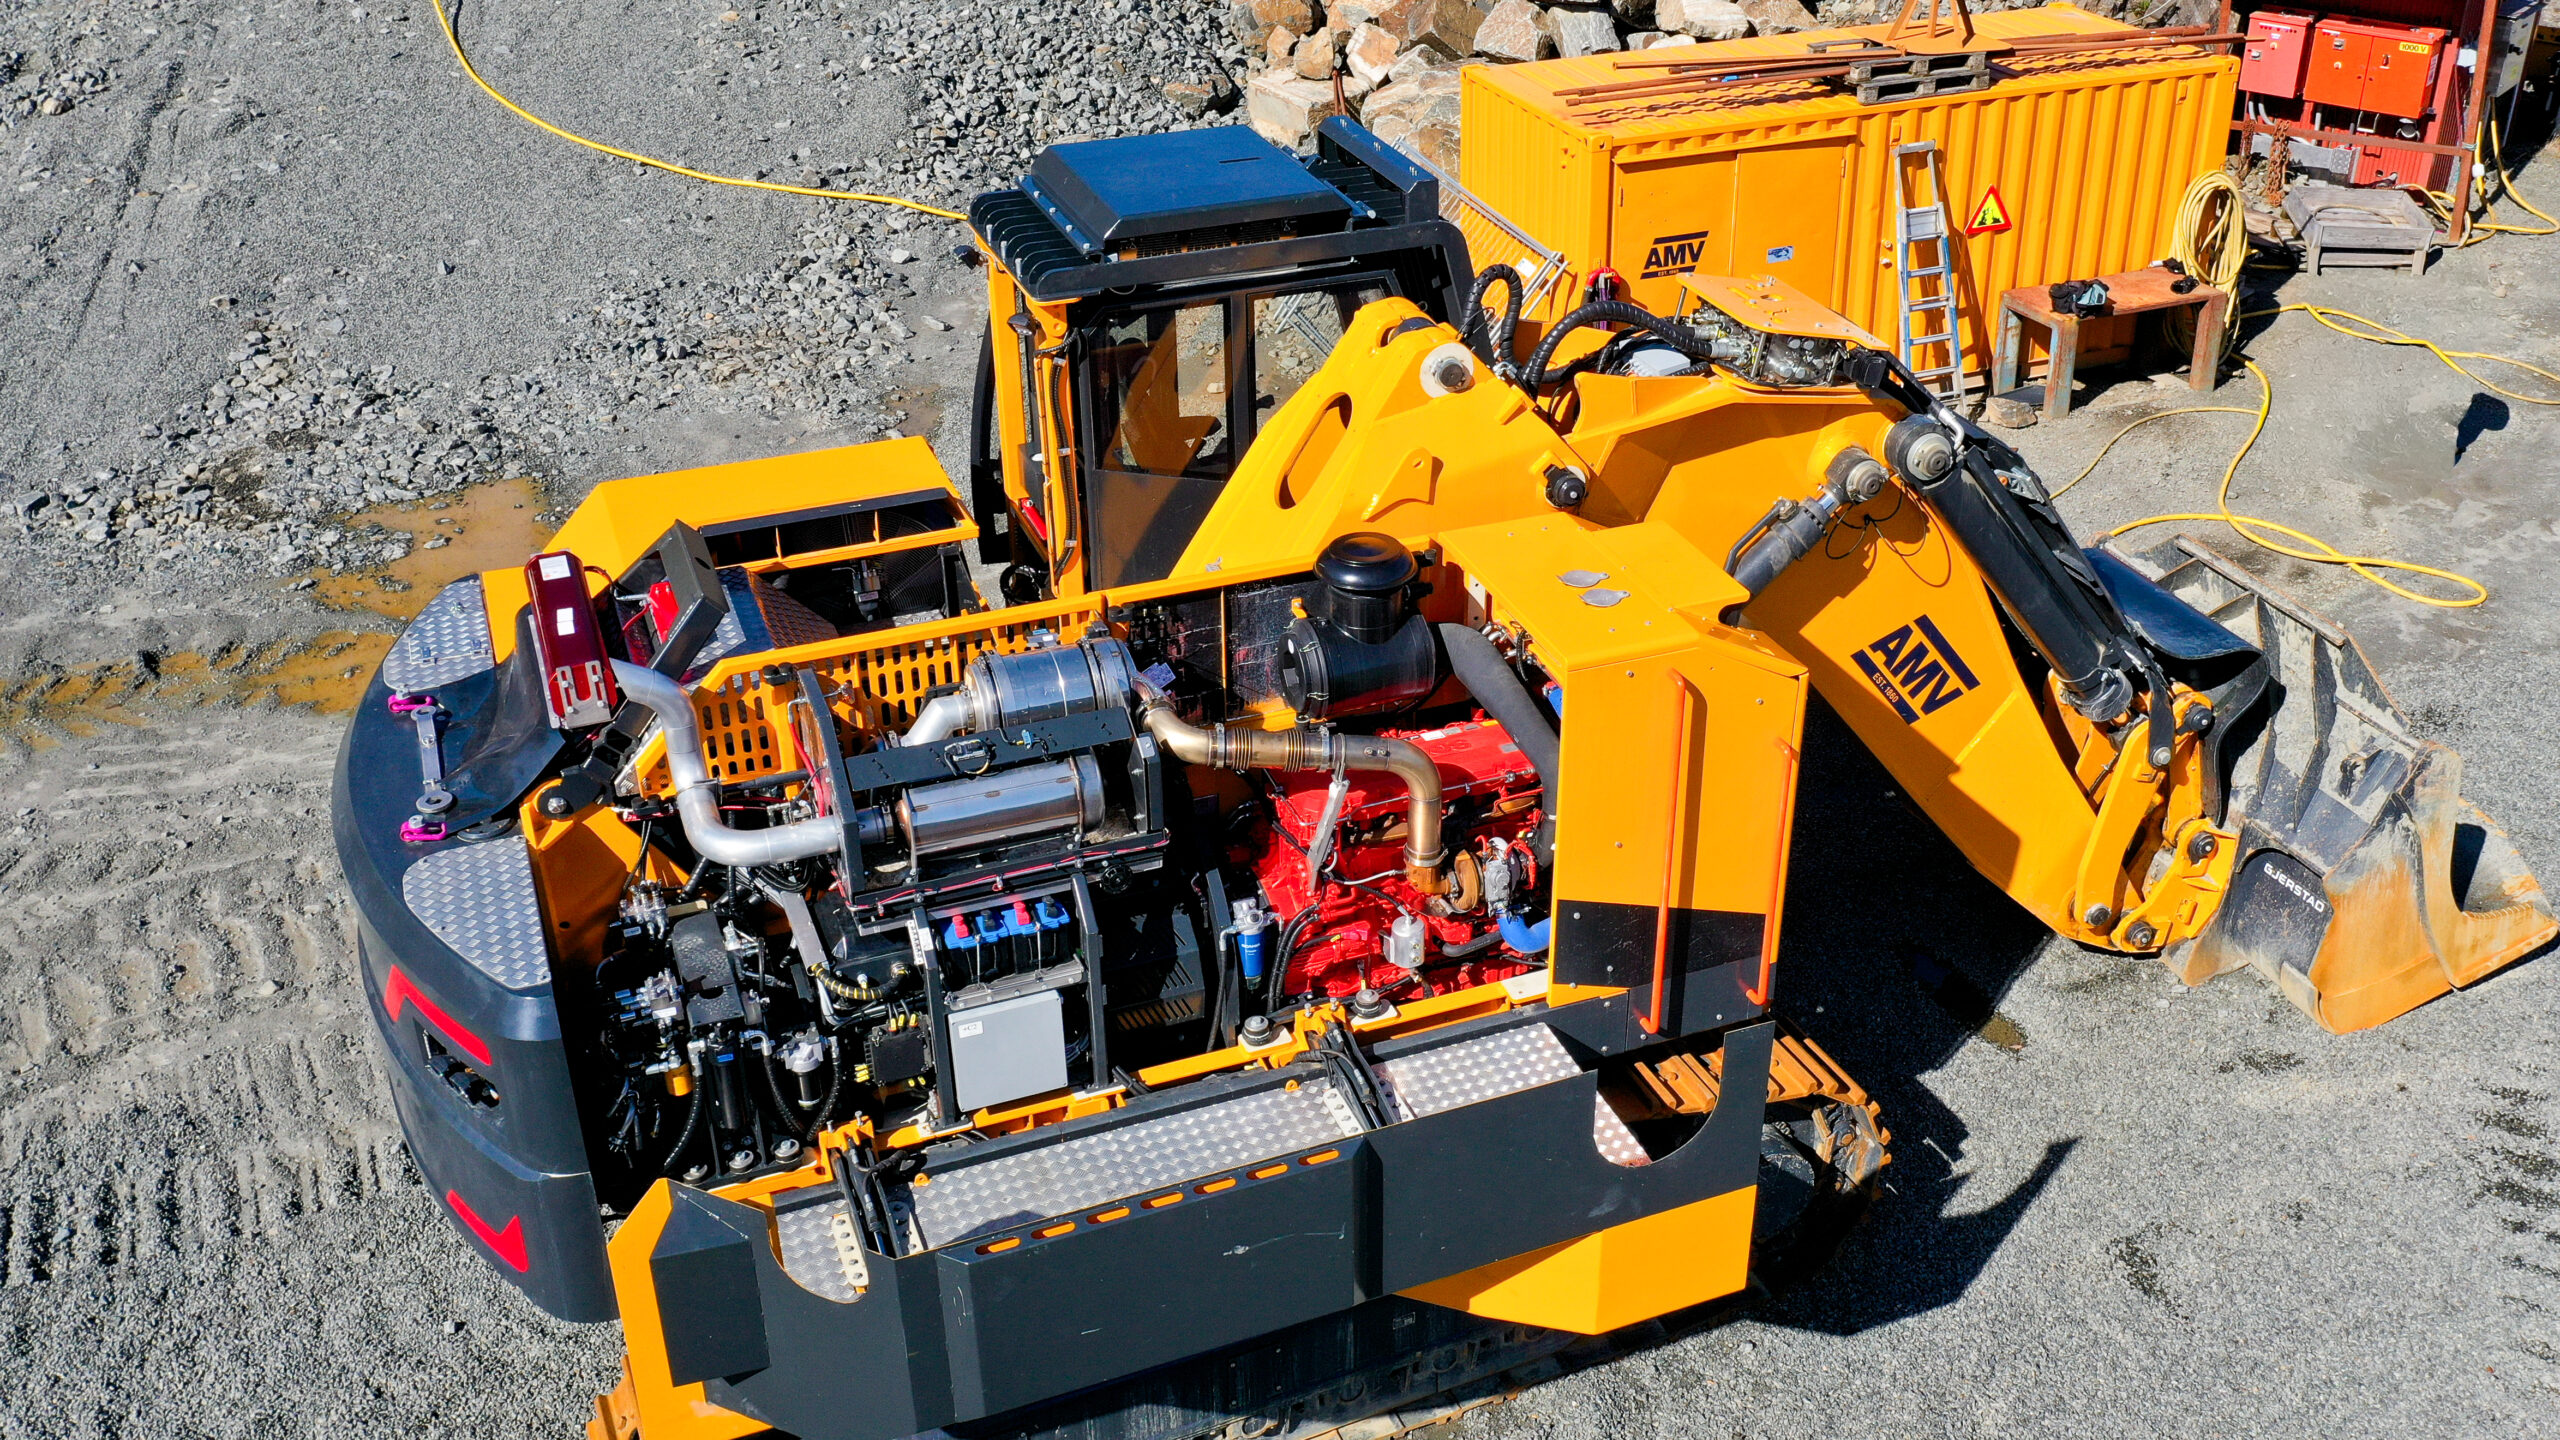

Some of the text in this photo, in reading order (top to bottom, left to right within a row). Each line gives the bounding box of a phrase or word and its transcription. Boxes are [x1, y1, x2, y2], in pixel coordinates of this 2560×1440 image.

[2401, 43, 2419, 52] 1000
[1643, 240, 1706, 271] AMV
[1868, 623, 1965, 716] AMV
[1872, 672, 1885, 690] EST.
[2263, 862, 2325, 913] GJERSTAD
